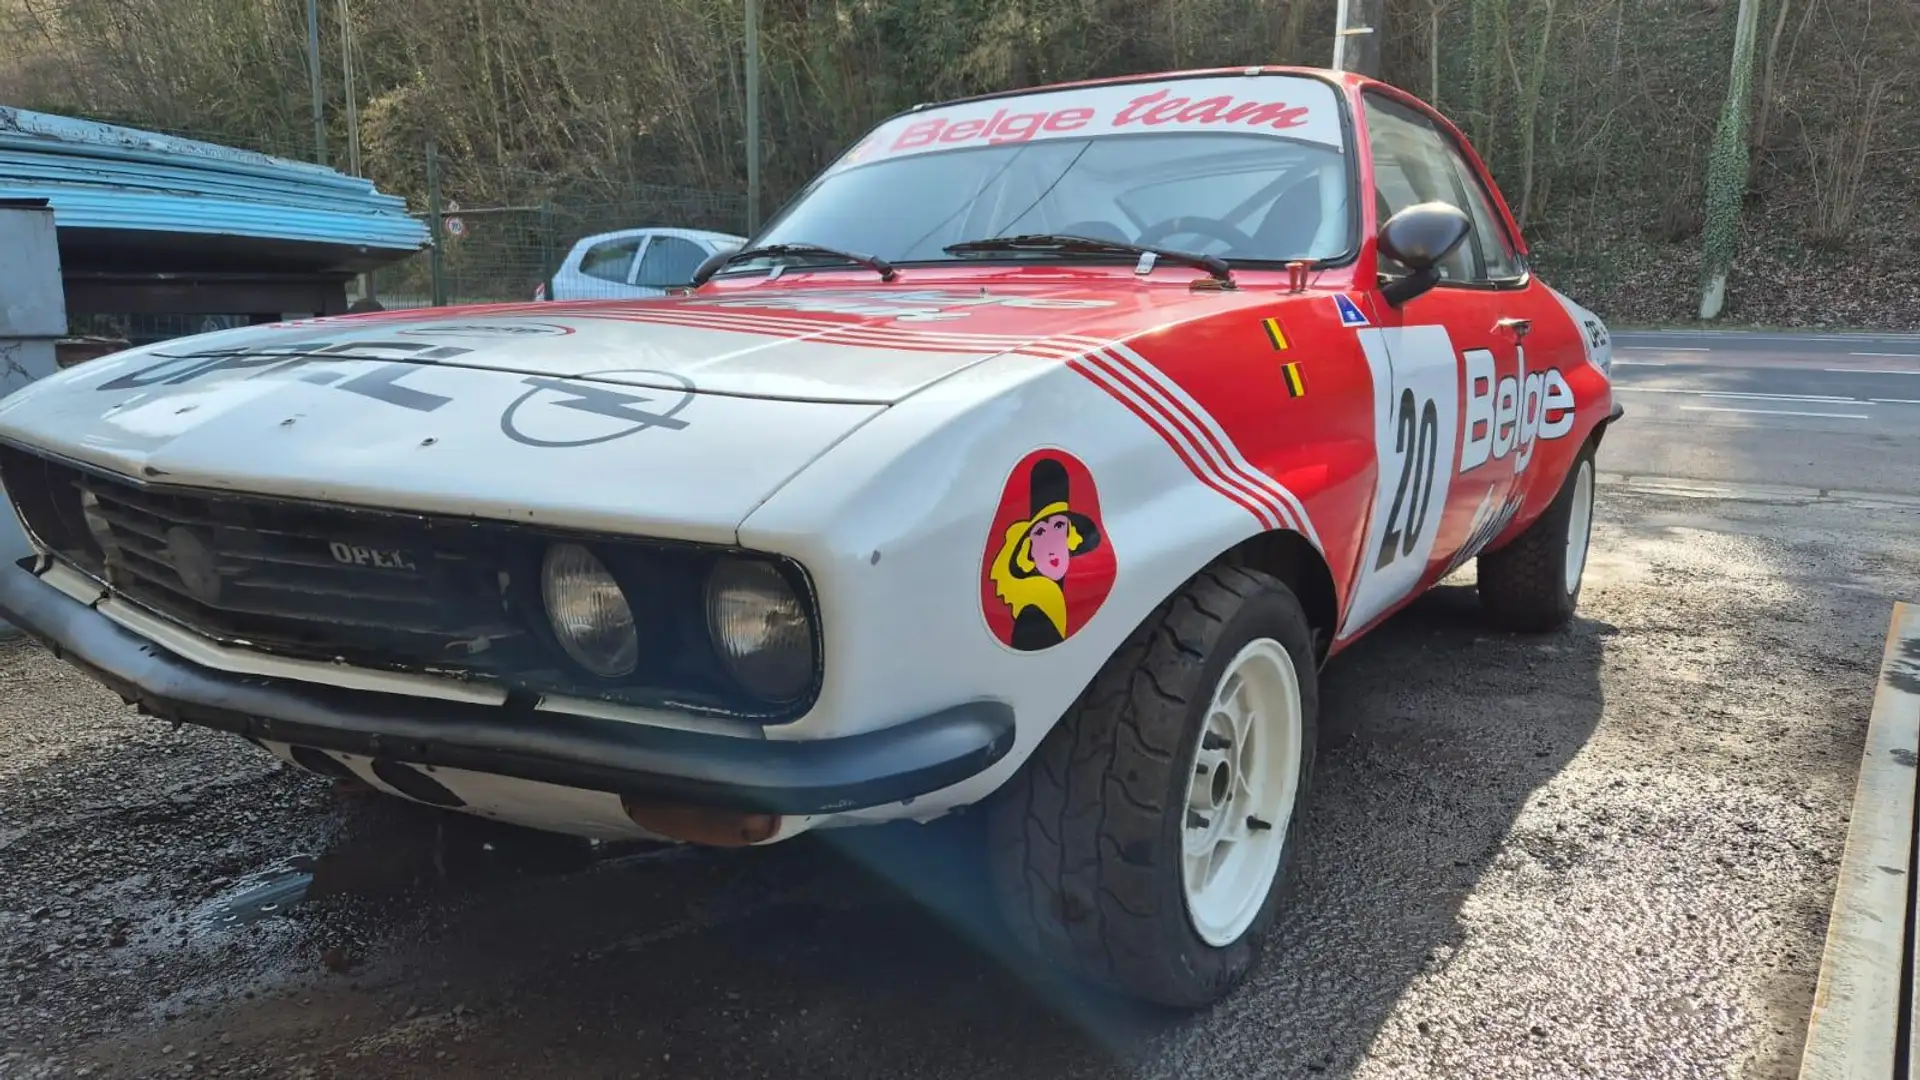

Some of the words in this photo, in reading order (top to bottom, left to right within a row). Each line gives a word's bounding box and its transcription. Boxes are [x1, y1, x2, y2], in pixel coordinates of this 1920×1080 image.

[889, 107, 1095, 146] Belge
[1111, 88, 1309, 129] team
[96, 342, 475, 412] OPEL
[1459, 344, 1576, 475] Belge
[1375, 387, 1438, 572] 20
[329, 541, 416, 571] OPEL
